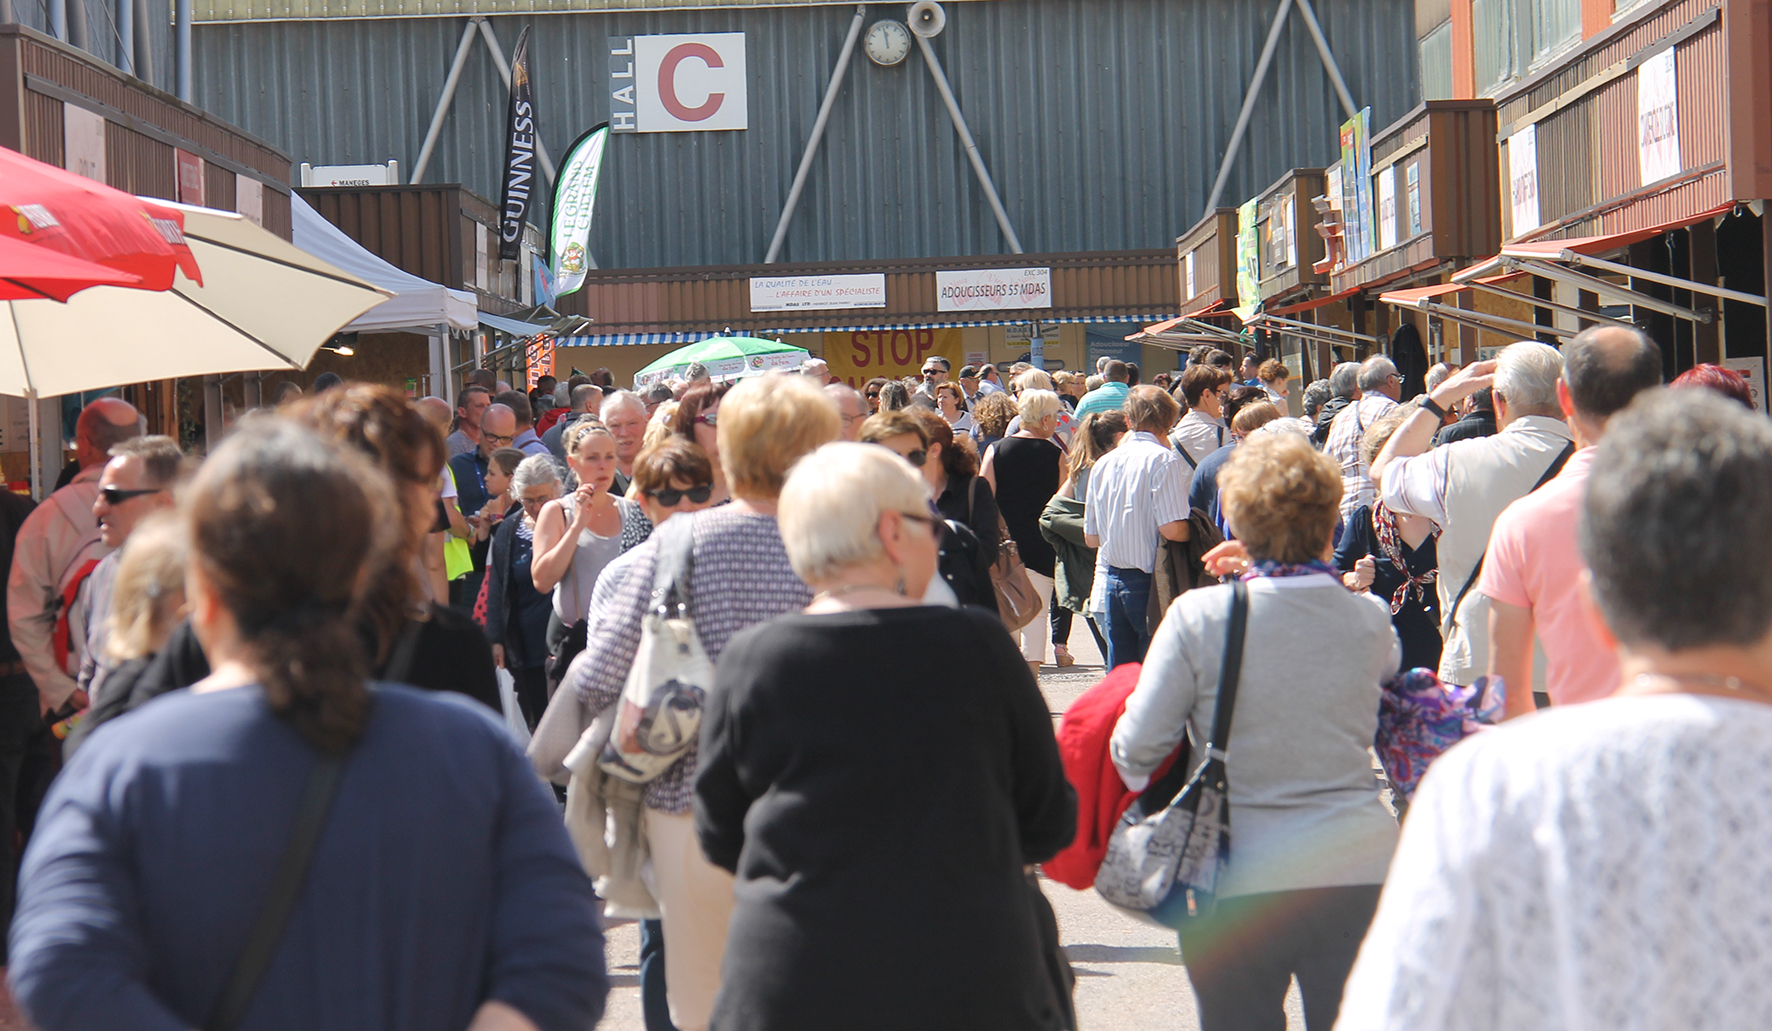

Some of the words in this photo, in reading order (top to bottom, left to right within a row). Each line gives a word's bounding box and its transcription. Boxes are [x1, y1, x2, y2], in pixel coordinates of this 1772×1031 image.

[611, 39, 635, 130] HALL
[657, 42, 725, 122] C
[502, 100, 534, 243] GUINNESS
[754, 281, 764, 289] LA
[799, 279, 809, 287] DE
[1037, 268, 1048, 276] 304
[775, 289, 812, 298] L'AFFAIRE
[814, 288, 832, 297] D'UN
[941, 283, 1007, 298] ADOUCISSEURS
[1008, 284, 1019, 296] 55
[1019, 282, 1046, 295] MDAS
[851, 329, 934, 368] STOP
